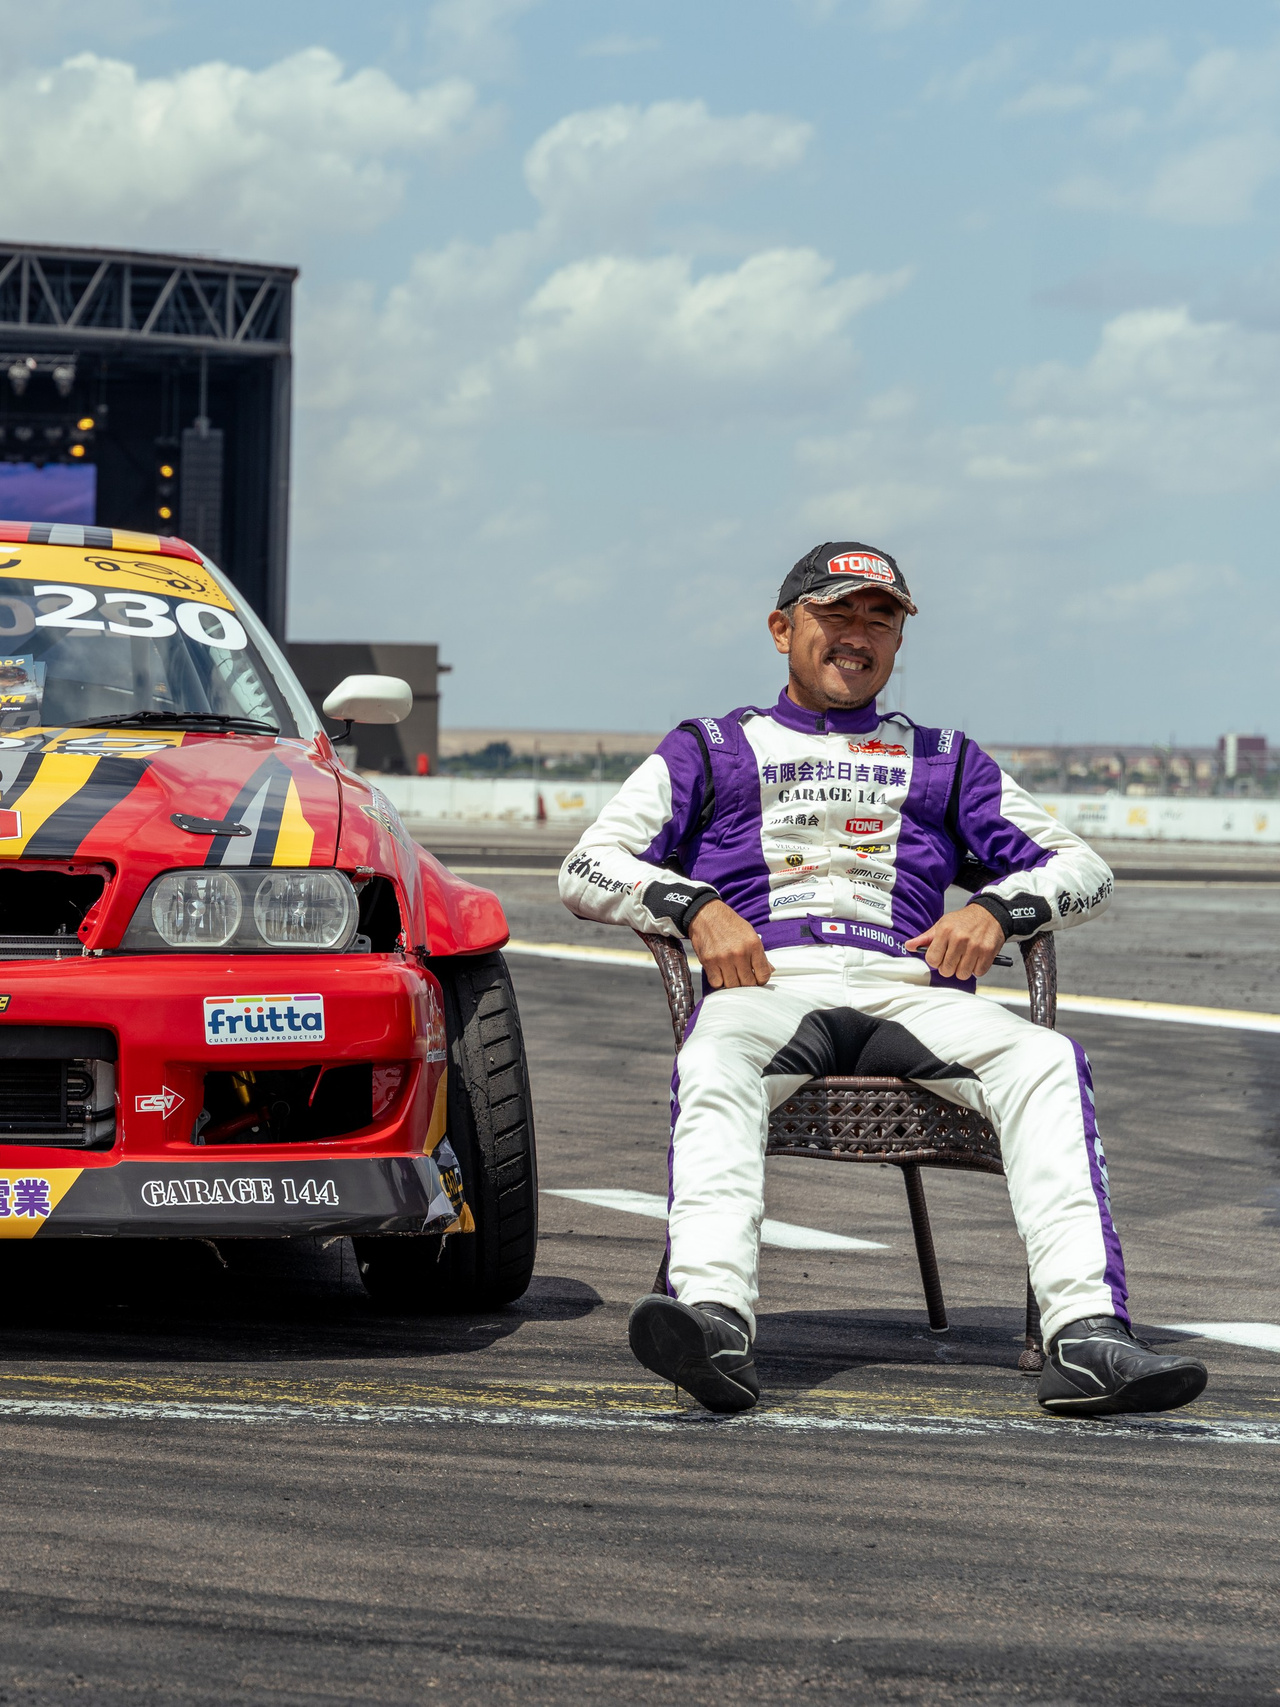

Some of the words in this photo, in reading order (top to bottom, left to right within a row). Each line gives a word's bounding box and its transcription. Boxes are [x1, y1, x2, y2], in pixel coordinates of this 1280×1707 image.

[834, 556, 891, 578] TONE
[32, 584, 248, 651] 230
[762, 760, 907, 788] 有限会社日吉電業
[778, 787, 852, 804] GARAGE
[857, 789, 888, 805] 144
[849, 820, 881, 832] TONE
[847, 867, 893, 882] SIMAGIC
[773, 892, 816, 907] RAYS
[850, 924, 894, 948] T.HIBINO
[207, 1006, 323, 1035] frütta
[141, 1178, 275, 1207] GARAGE
[281, 1178, 339, 1206] 144
